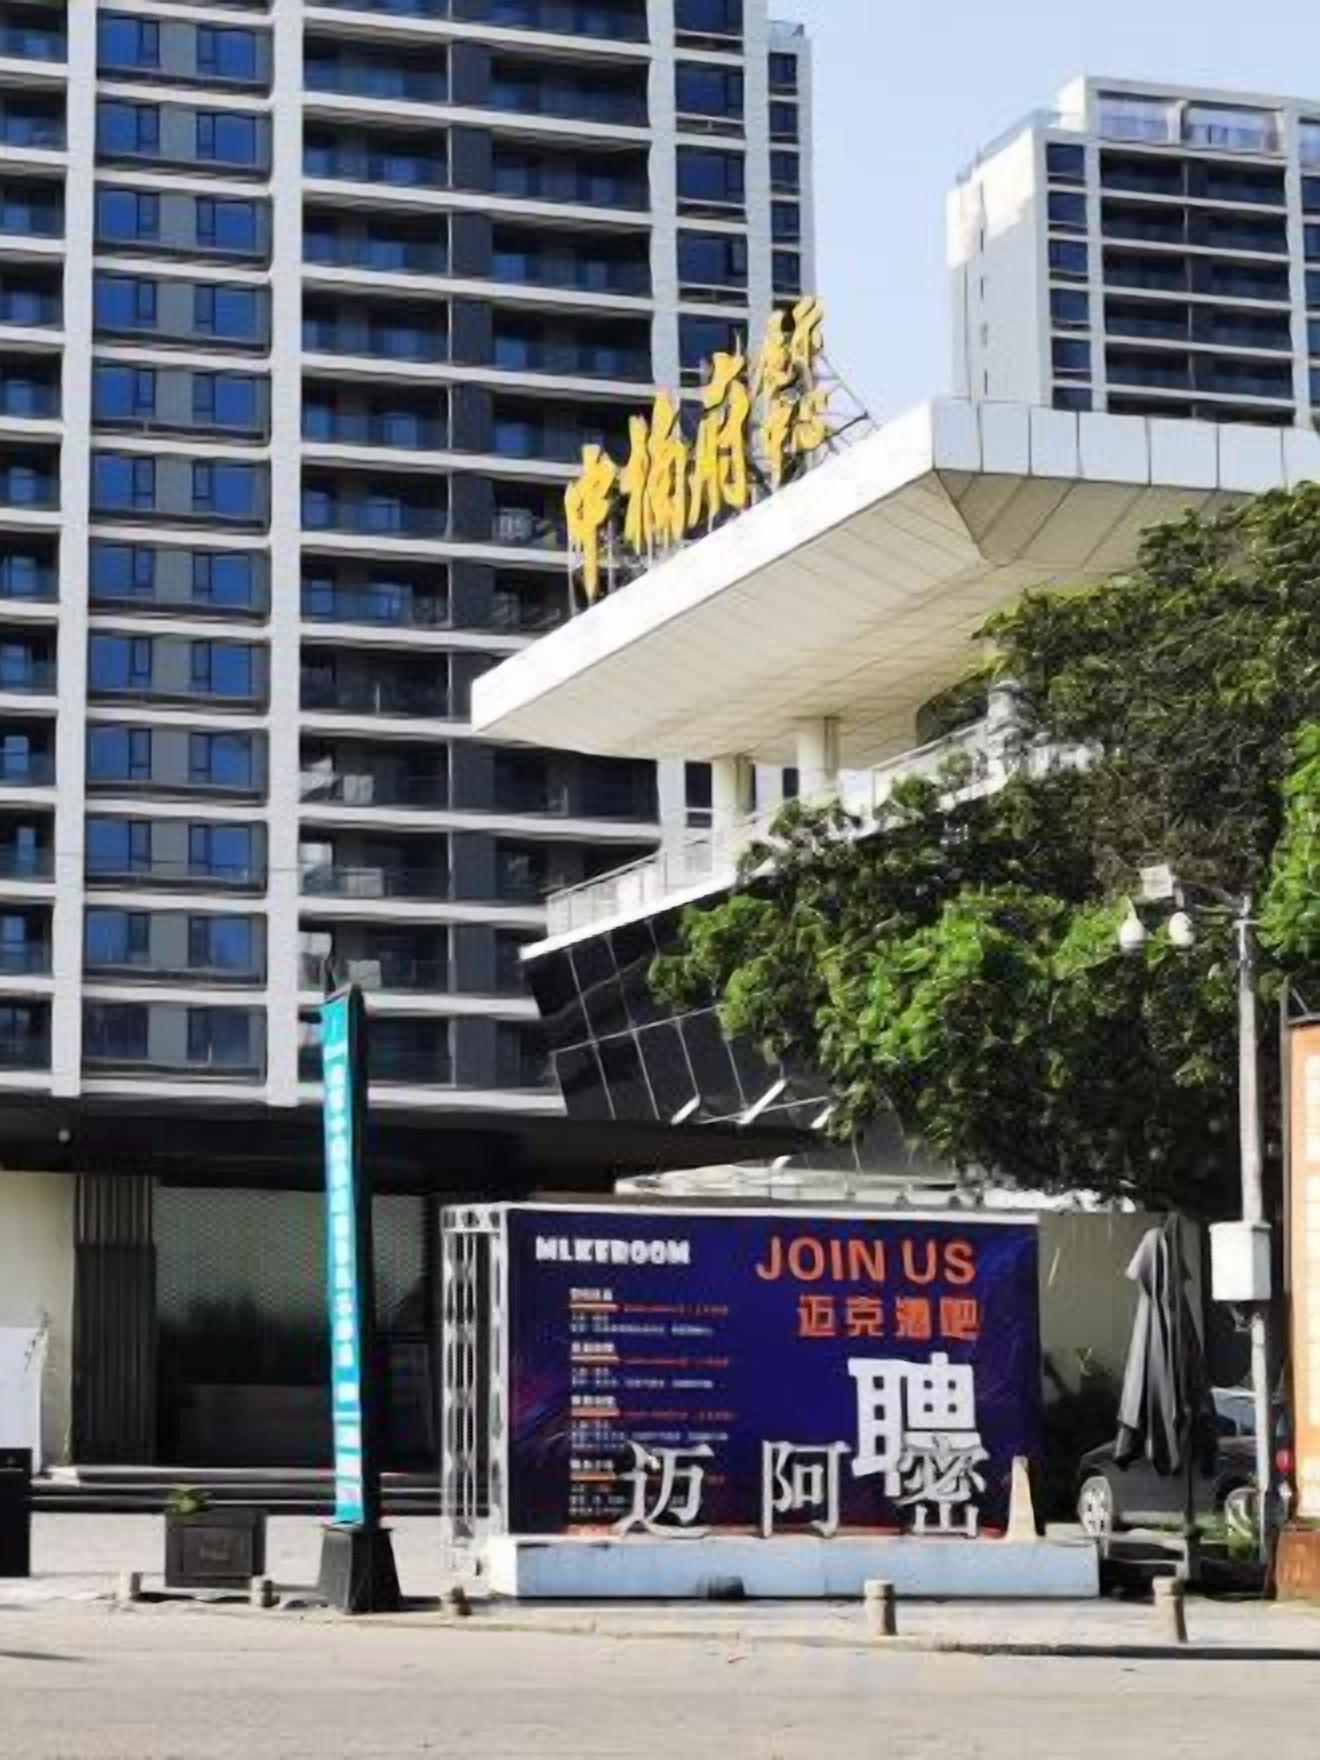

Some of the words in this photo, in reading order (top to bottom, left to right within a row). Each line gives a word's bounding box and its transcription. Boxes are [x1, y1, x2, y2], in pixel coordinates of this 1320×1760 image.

[756, 1236, 886, 1281] JOIN
[902, 1239, 977, 1284] US
[610, 1433, 991, 1540] 迈阿密
